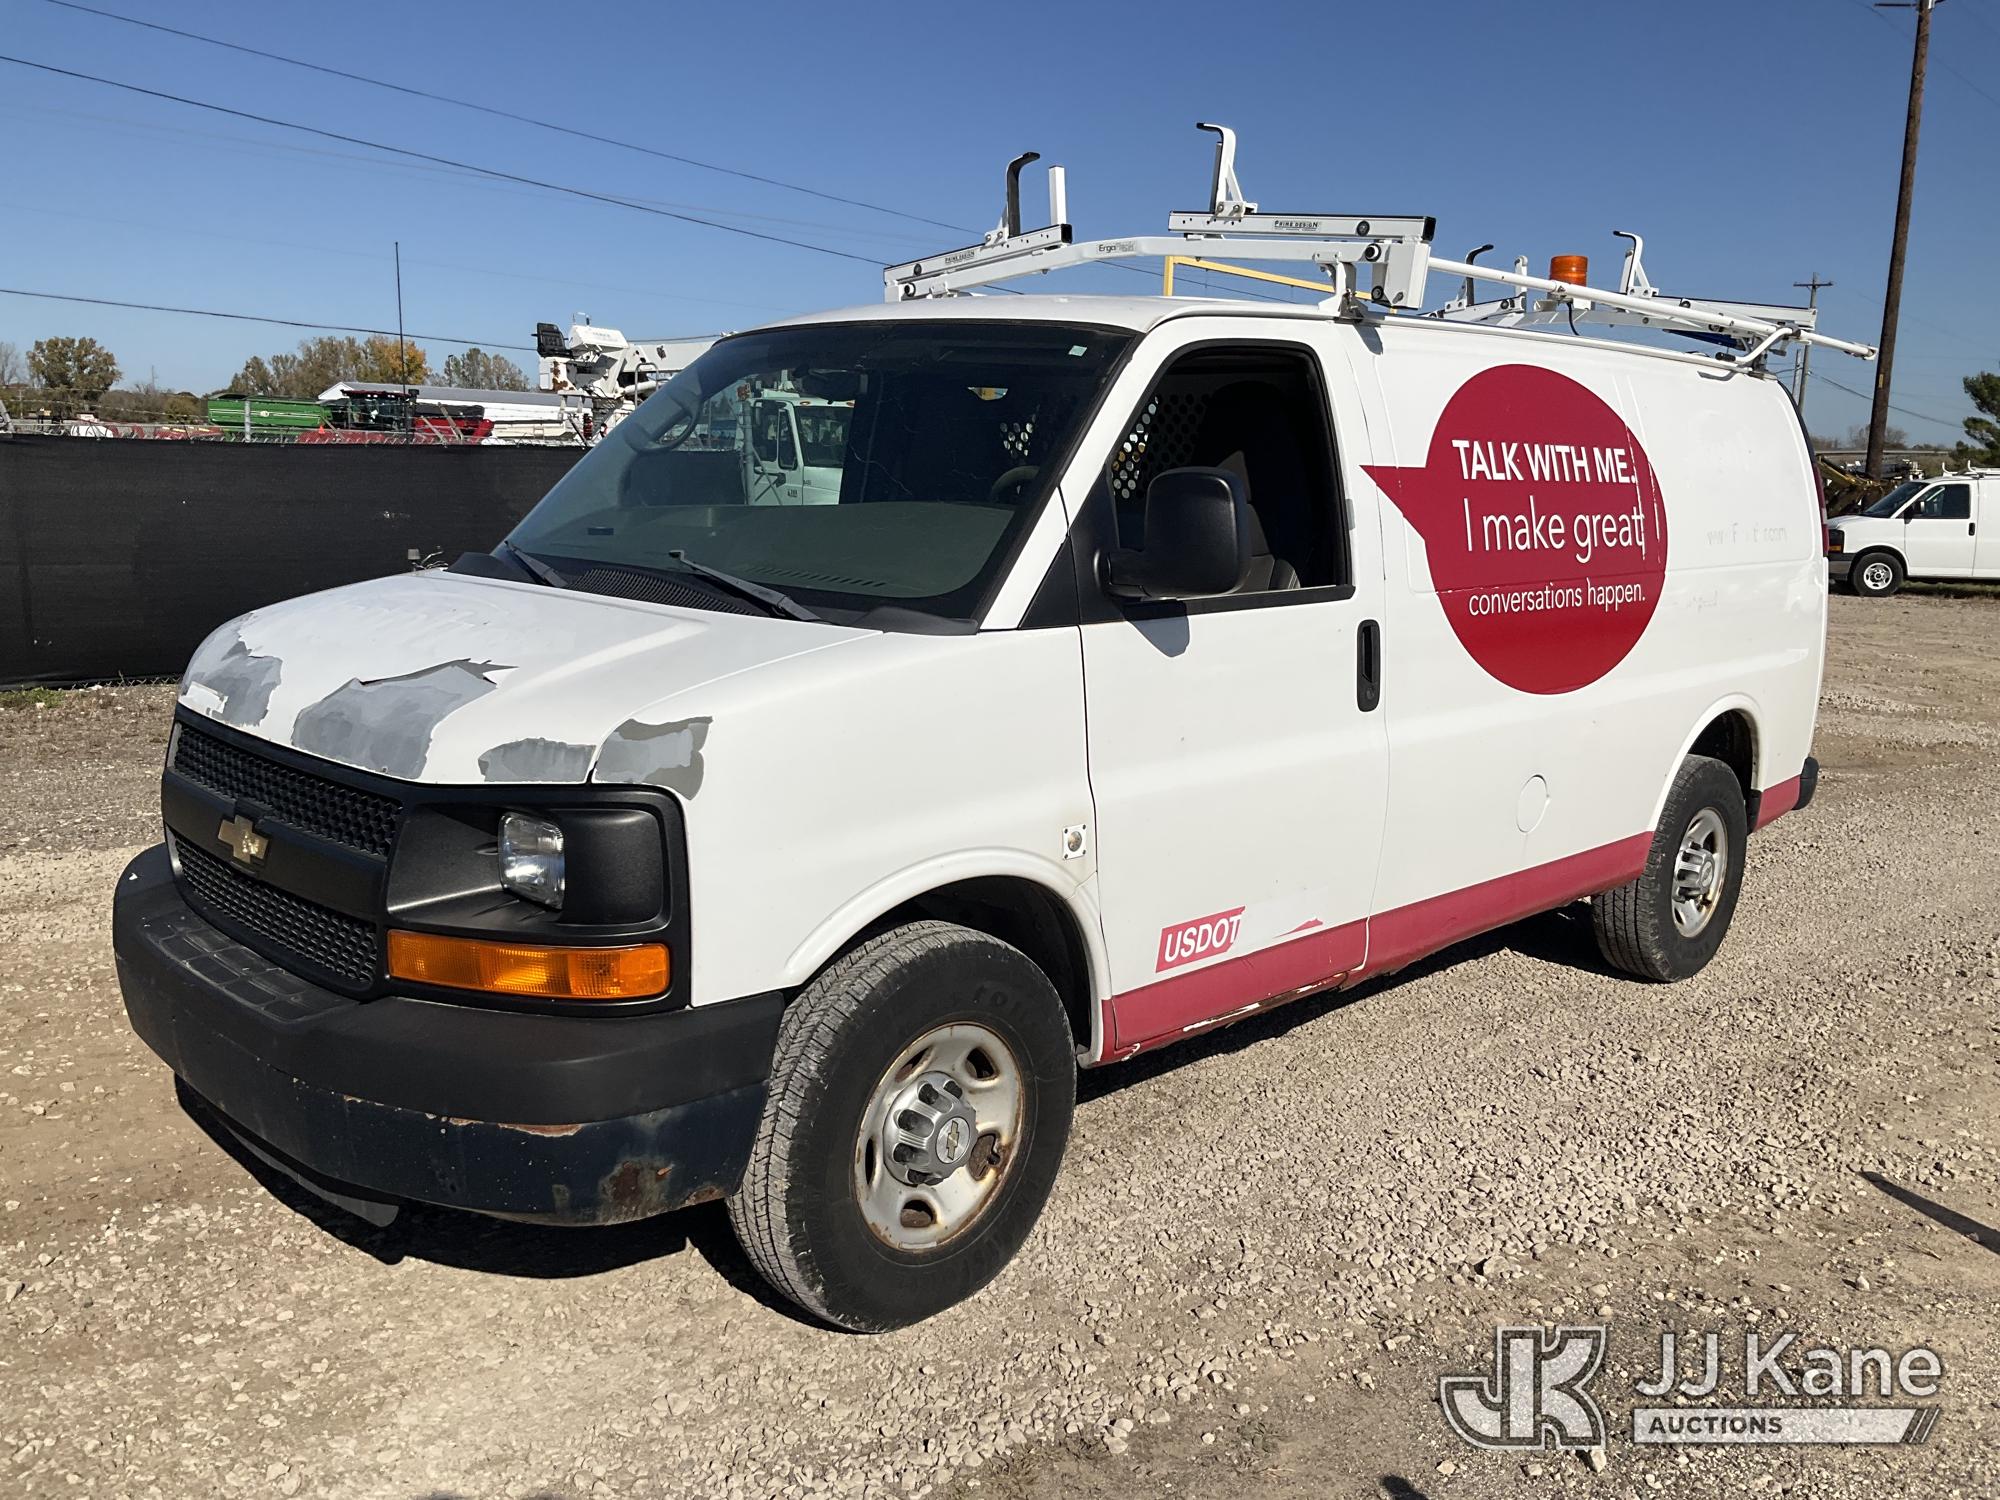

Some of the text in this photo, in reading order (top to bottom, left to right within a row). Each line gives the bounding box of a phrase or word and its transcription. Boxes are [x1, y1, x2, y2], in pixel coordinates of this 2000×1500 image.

[1452, 439, 1637, 484] TALK WITH ME.
[1464, 497, 1473, 552] I
[1482, 495, 1566, 551] make
[1573, 506, 1645, 564] great
[1469, 582, 1583, 616] conversations
[1586, 577, 1646, 612] happen.
[1164, 914, 1242, 963] USDOT
